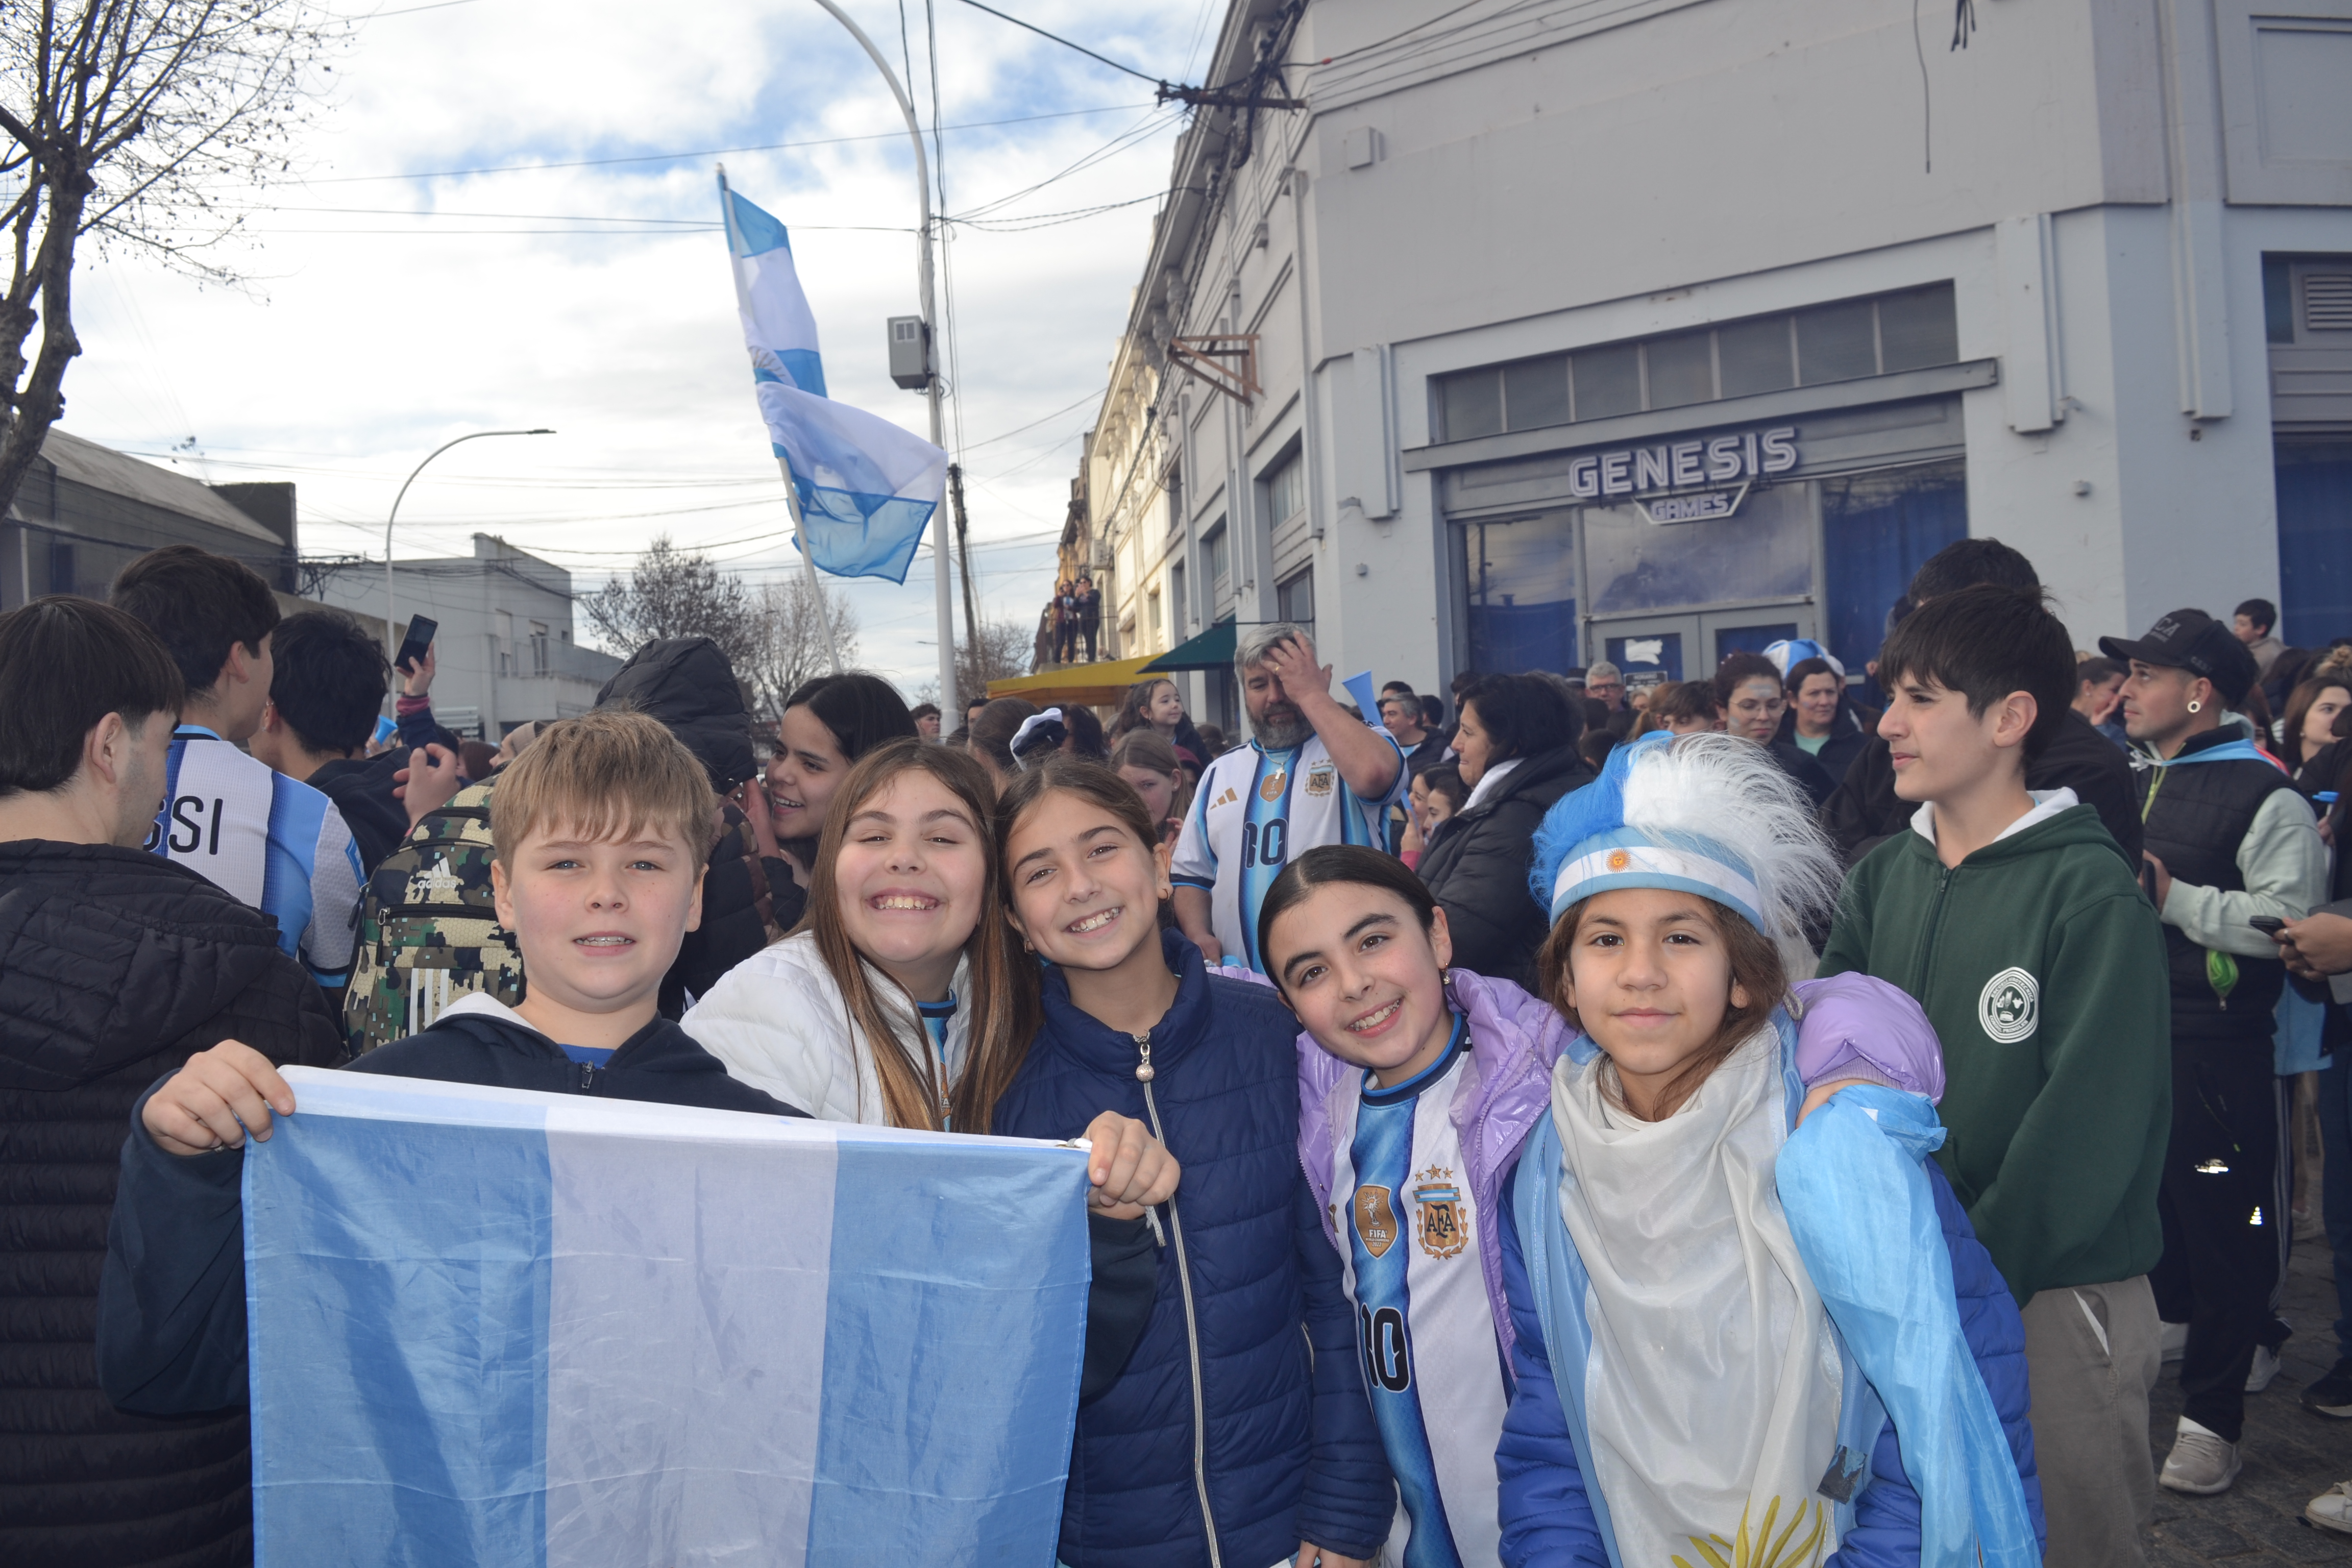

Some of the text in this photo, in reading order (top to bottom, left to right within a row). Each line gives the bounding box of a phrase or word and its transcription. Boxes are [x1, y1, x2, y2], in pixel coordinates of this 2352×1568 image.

[1569, 426, 1797, 498] GENESIS
[1650, 494, 1729, 520] GAMES
[1311, 773, 1330, 789] AFA
[1244, 818, 1288, 869] 10
[418, 877, 457, 889] adidas
[1369, 1229, 1387, 1238] FIFA
[1427, 1204, 1456, 1238] AFA
[1361, 1303, 1410, 1393] 10
